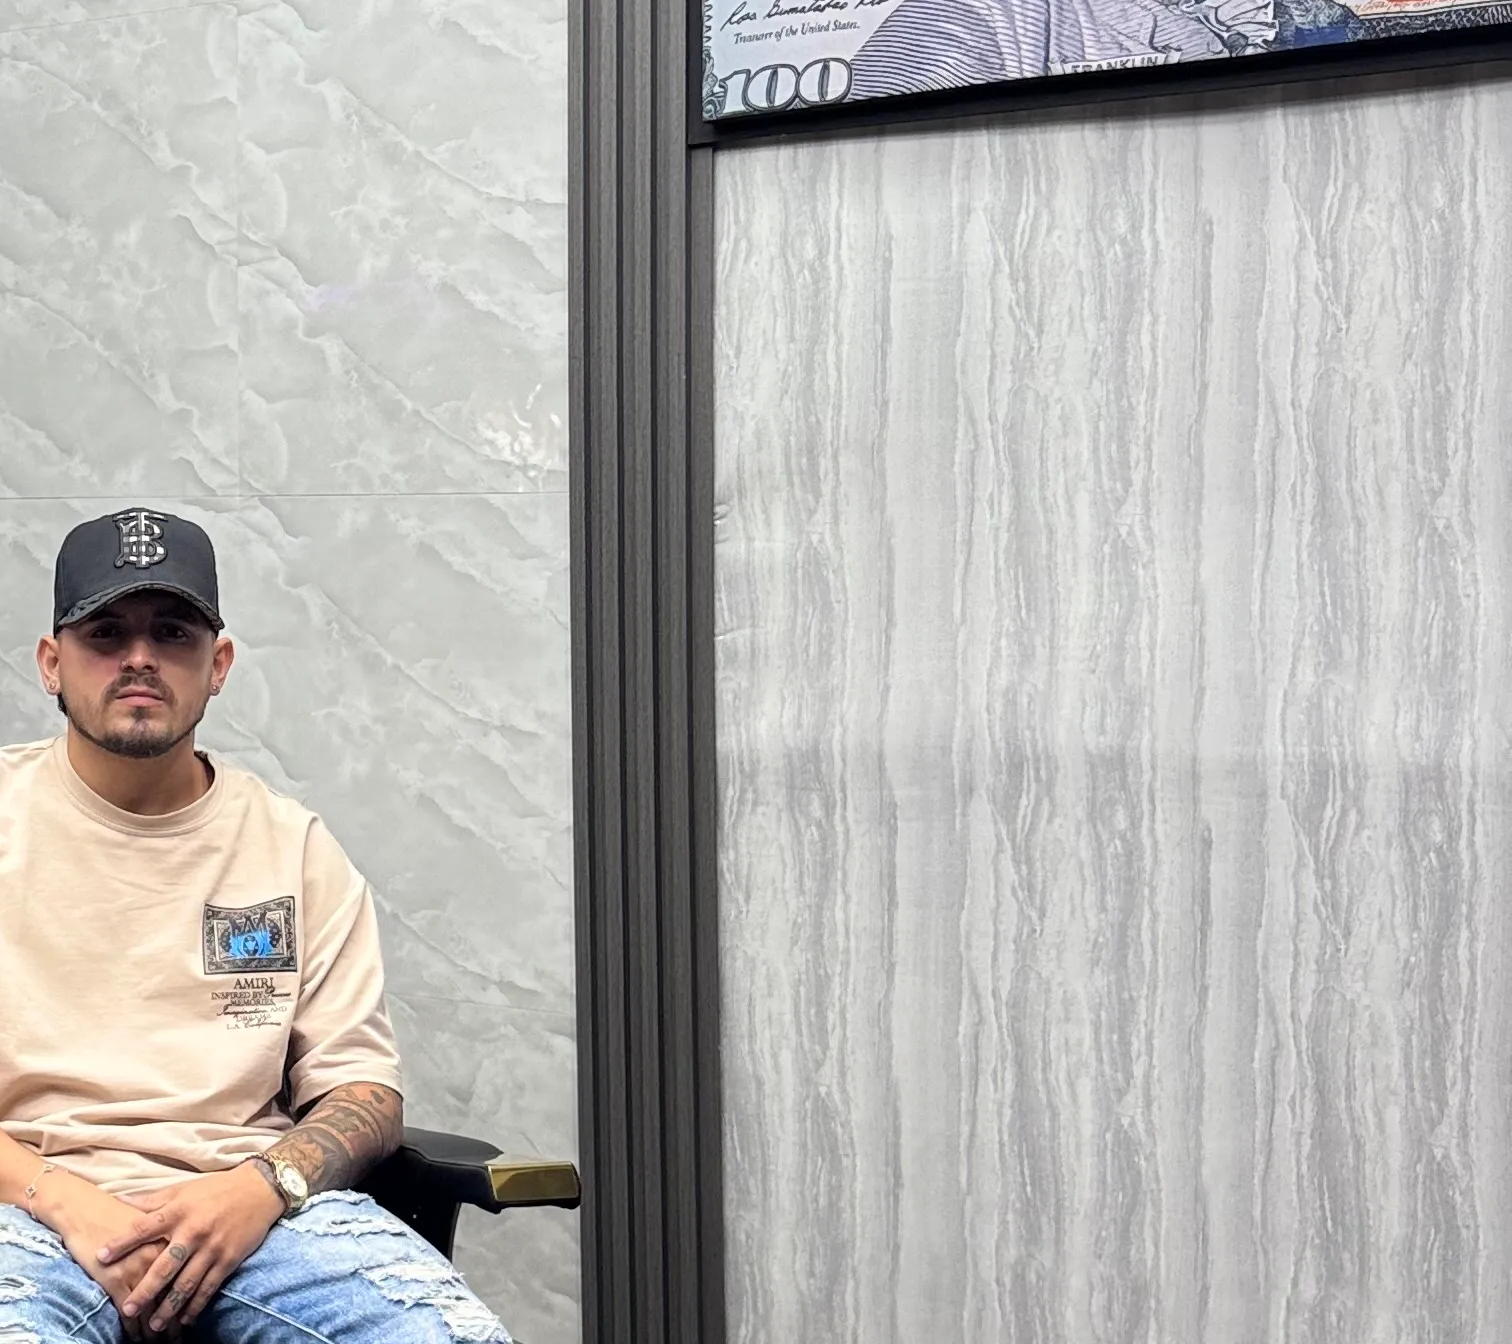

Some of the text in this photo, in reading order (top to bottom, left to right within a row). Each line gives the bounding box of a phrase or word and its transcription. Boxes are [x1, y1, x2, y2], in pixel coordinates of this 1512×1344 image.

[774, 26, 785, 41] of
[785, 23, 798, 38] the
[800, 19, 831, 35] United
[719, 58, 853, 113] 100
[233, 977, 276, 989] AMIRI
